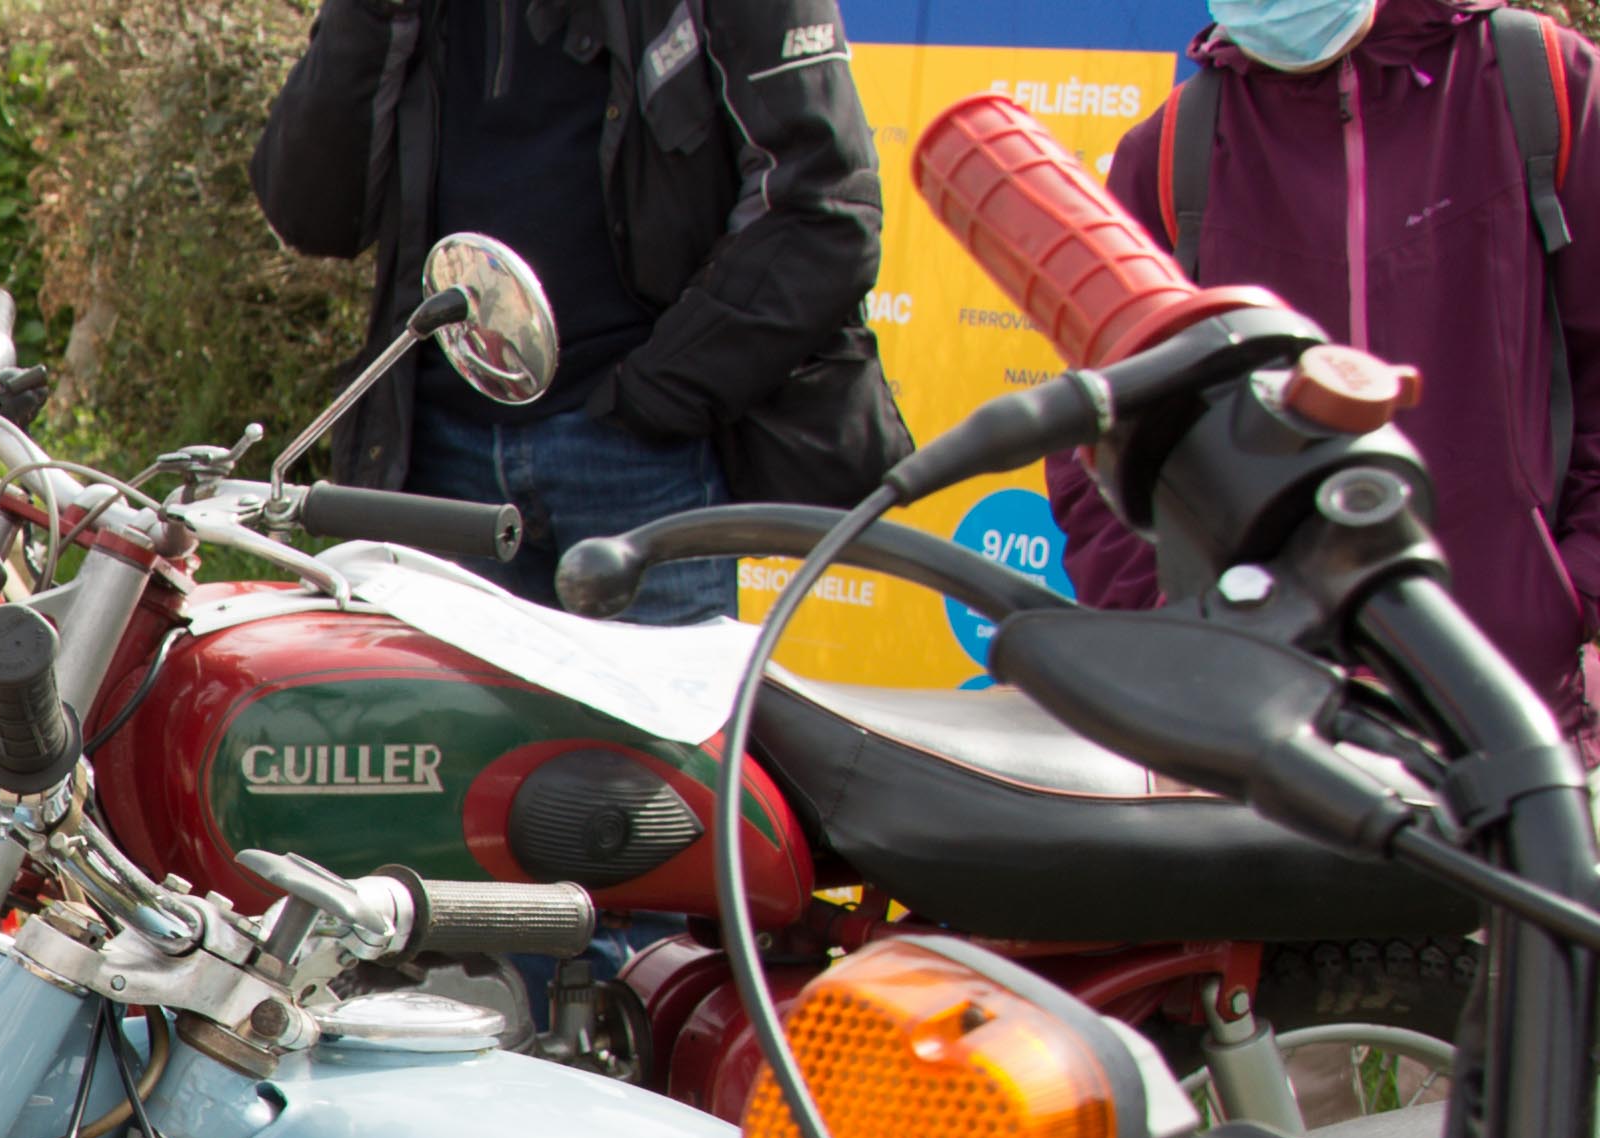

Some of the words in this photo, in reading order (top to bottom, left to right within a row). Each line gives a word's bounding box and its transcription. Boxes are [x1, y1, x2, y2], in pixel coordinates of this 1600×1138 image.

[1016, 74, 1141, 117] FILIÈRES
[1004, 367, 1057, 385] NAVA
[982, 529, 1050, 569] 9/10
[738, 563, 874, 606] SSIONELLE
[241, 744, 443, 789] GUILLER
